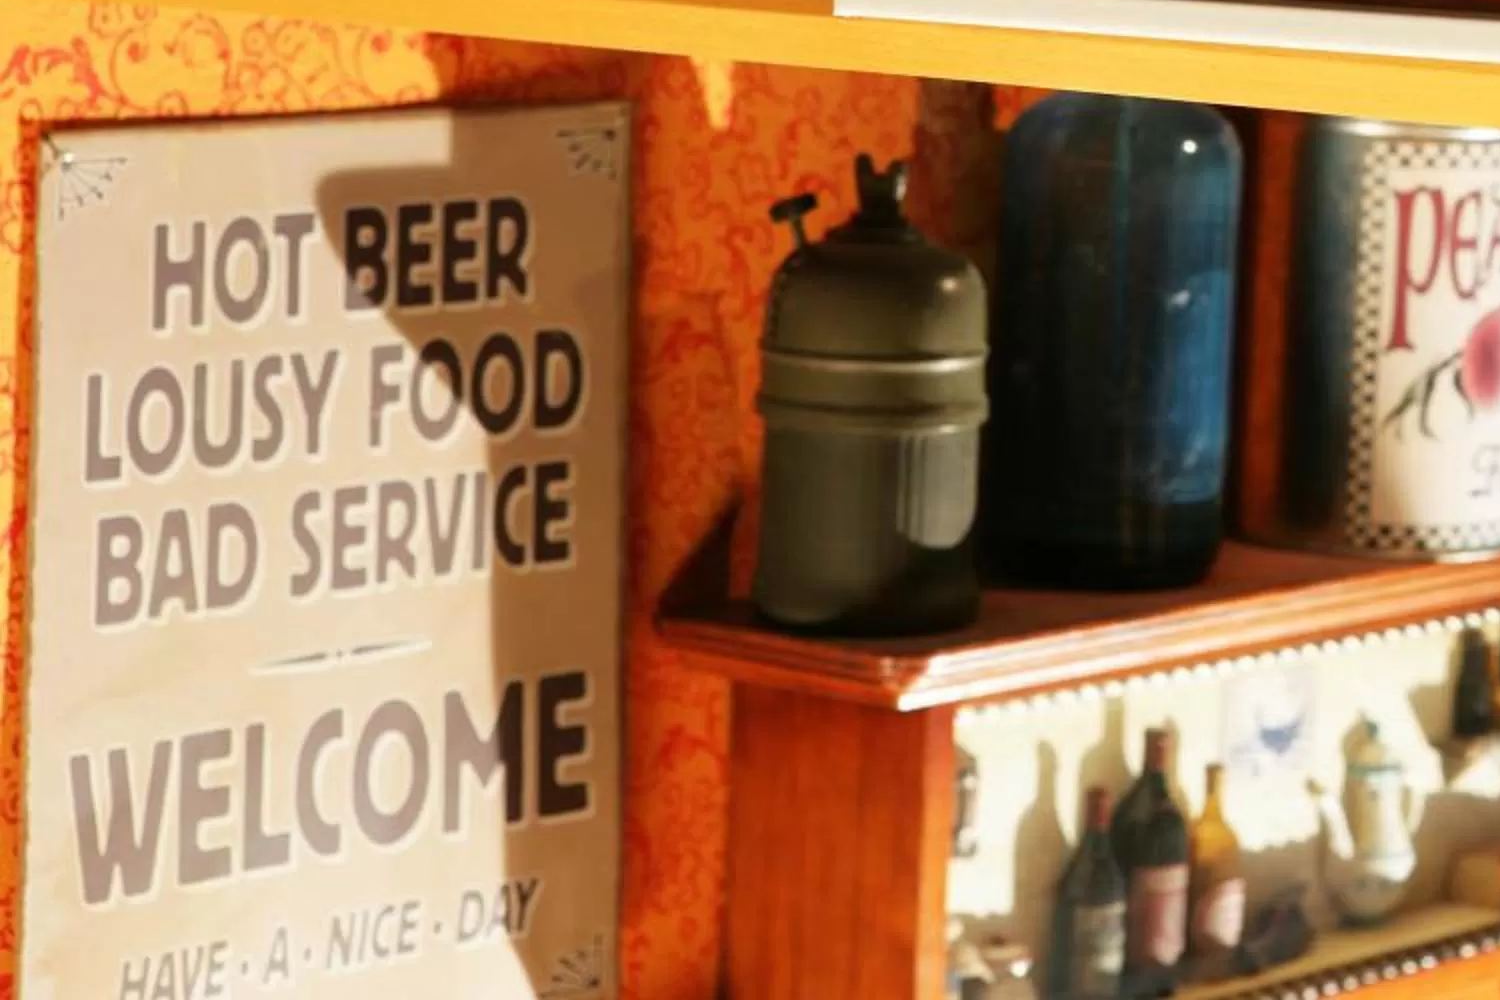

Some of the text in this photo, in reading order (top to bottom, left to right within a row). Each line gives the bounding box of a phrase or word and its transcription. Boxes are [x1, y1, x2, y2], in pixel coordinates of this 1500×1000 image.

[153, 197, 529, 330] HOT BEER
[83, 329, 584, 484] LOUSY FOOD
[94, 460, 571, 627] BAD SERVICE
[69, 670, 588, 906] WELCOME
[119, 878, 539, 1000] HAVE A NICE DAY
